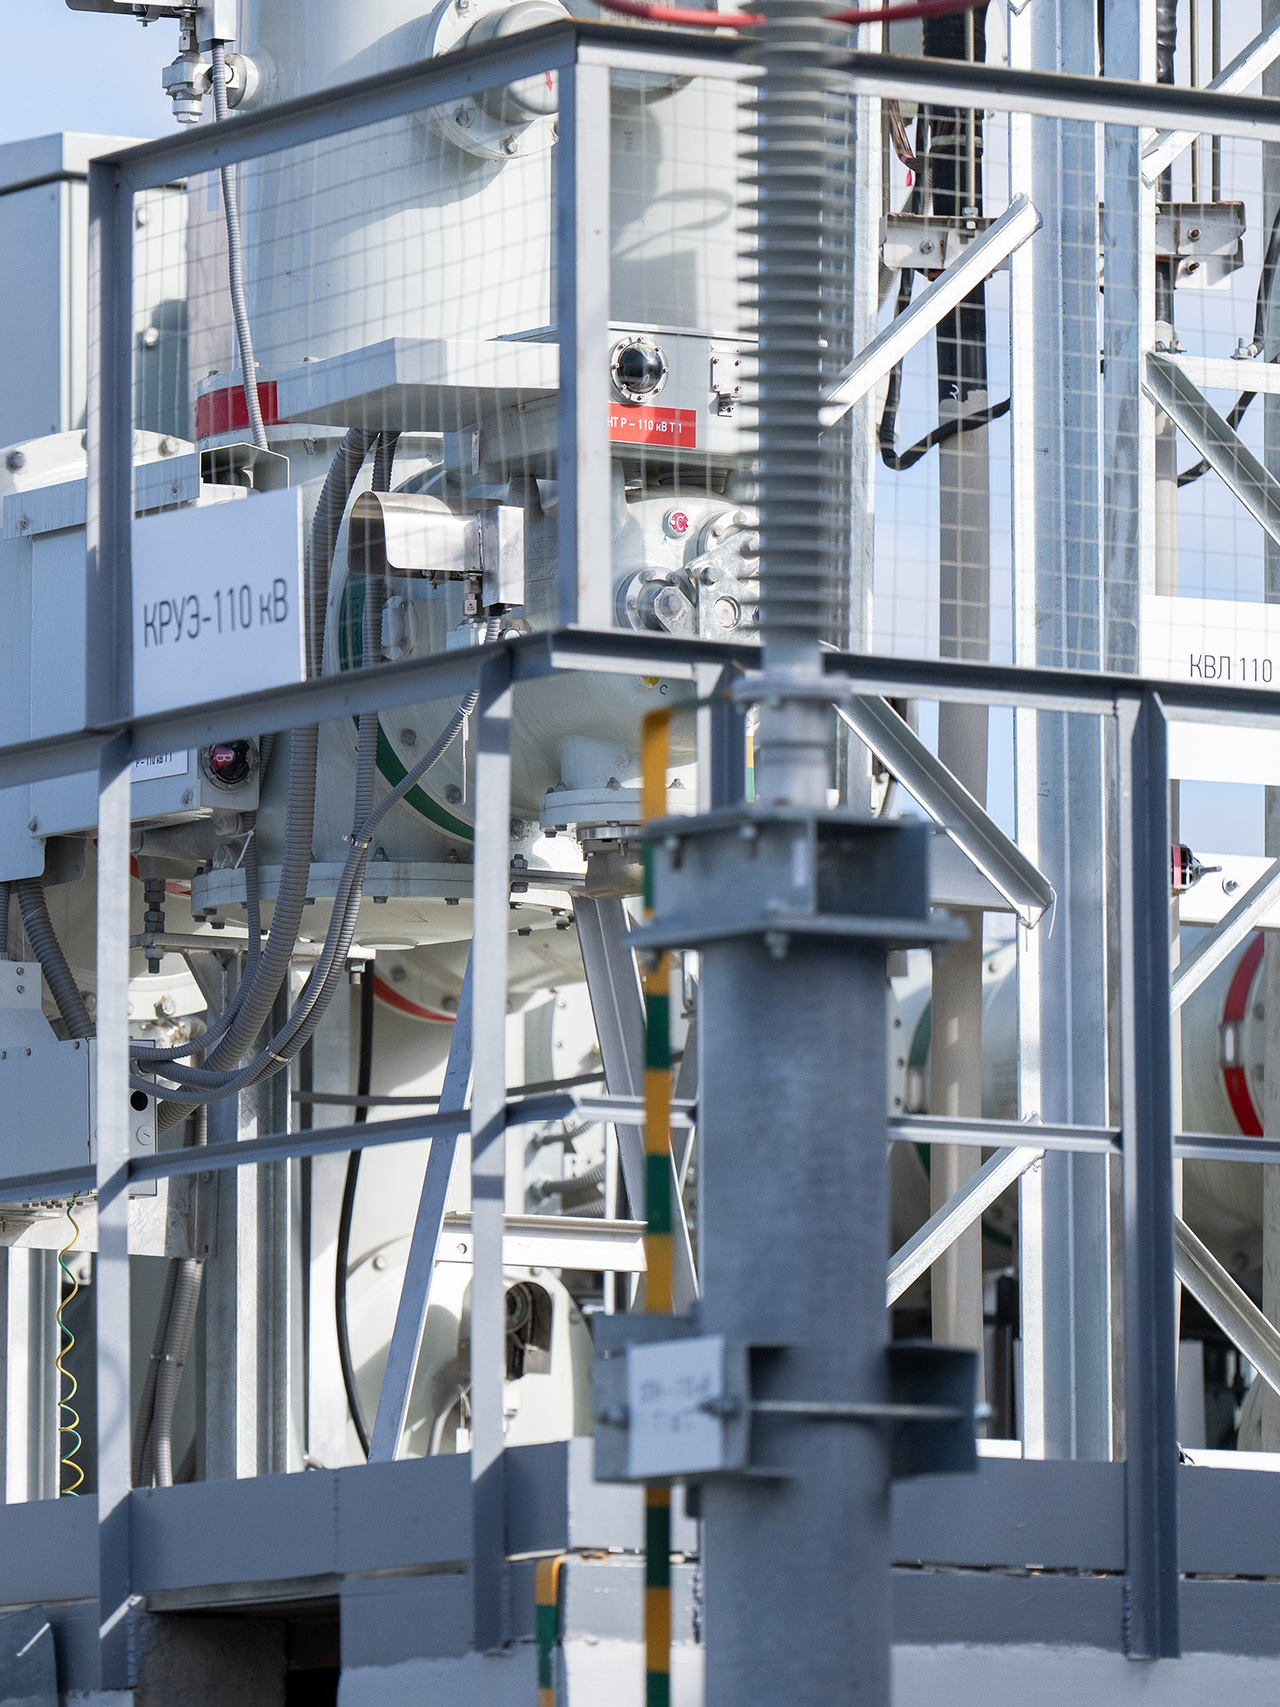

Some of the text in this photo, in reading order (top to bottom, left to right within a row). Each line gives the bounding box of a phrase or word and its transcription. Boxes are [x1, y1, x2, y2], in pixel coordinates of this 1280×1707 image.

[638, 419, 654, 431] 110
[656, 422, 667, 433] кВ
[143, 578, 289, 648] КРУЭ-110 кВ
[1190, 653, 1273, 683] КВЛ 110
